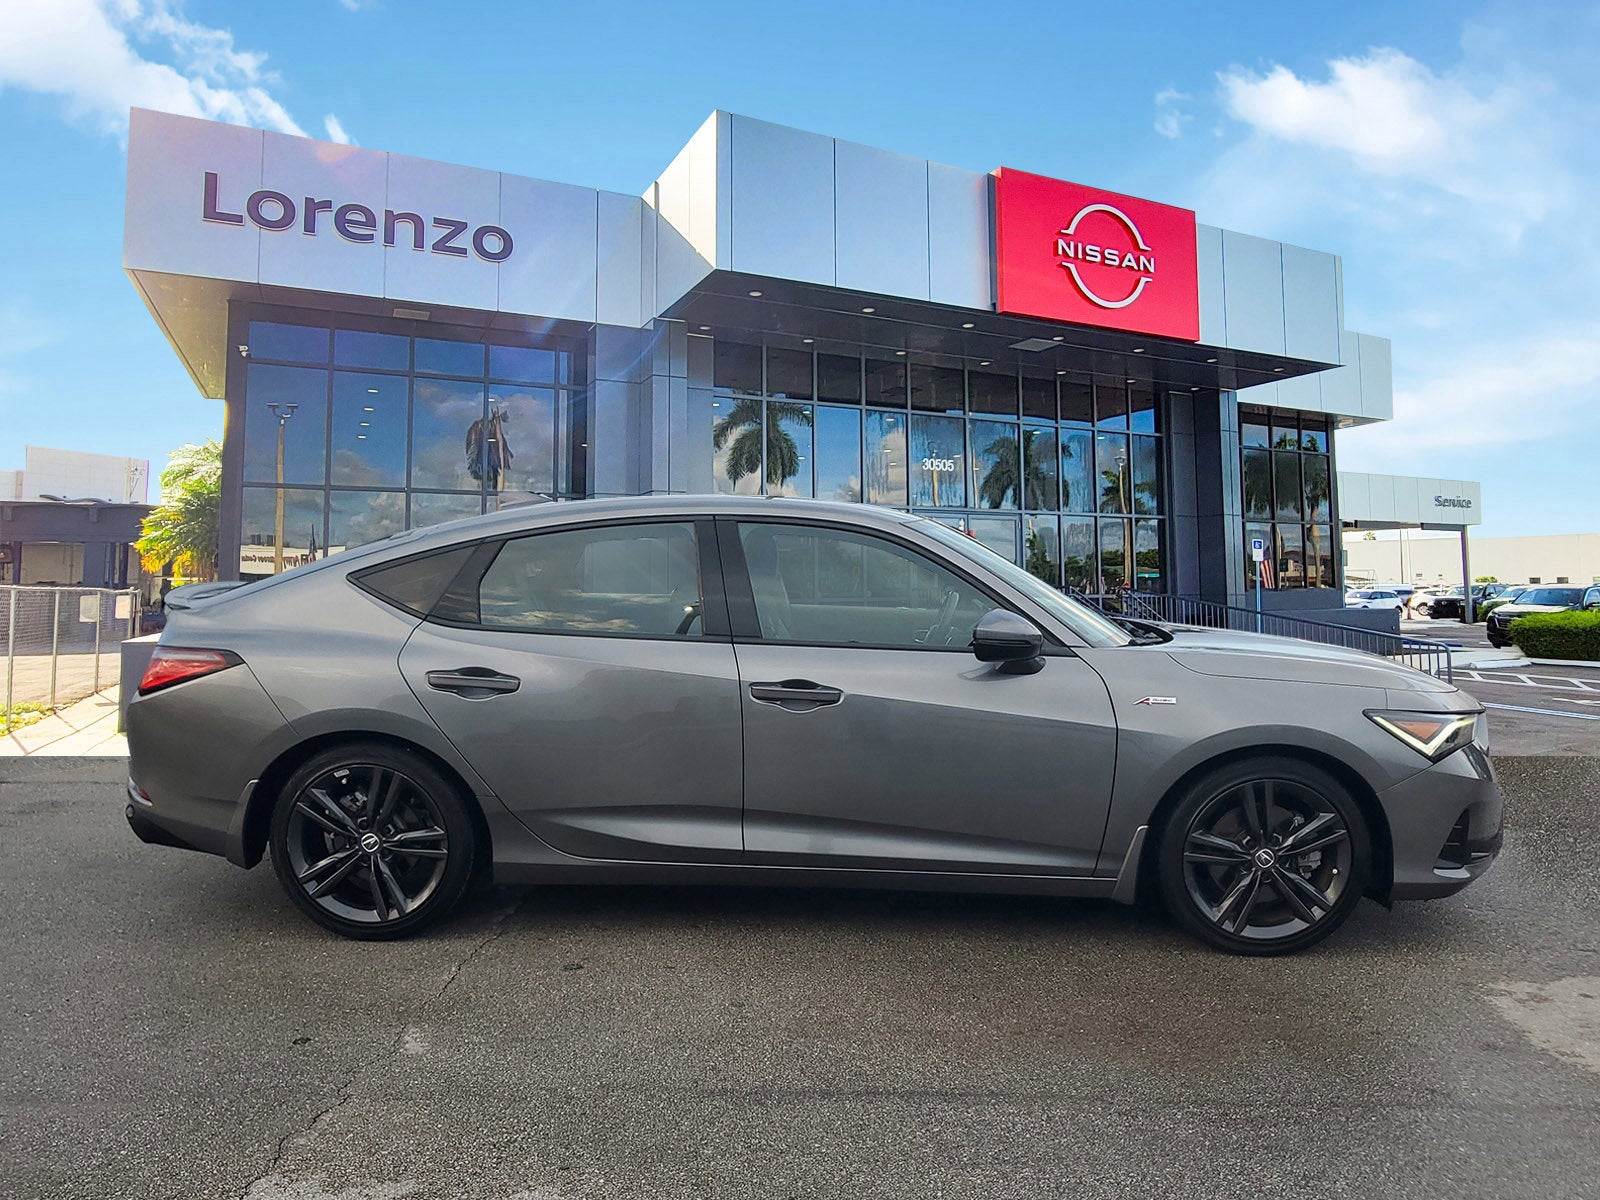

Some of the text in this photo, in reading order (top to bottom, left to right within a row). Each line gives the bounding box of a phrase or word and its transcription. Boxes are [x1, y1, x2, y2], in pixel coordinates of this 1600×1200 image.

[203, 171, 514, 262] Lorenzo
[1057, 238, 1155, 273] NISSAN
[922, 457, 955, 472] 30505
[1434, 495, 1472, 508] Service
